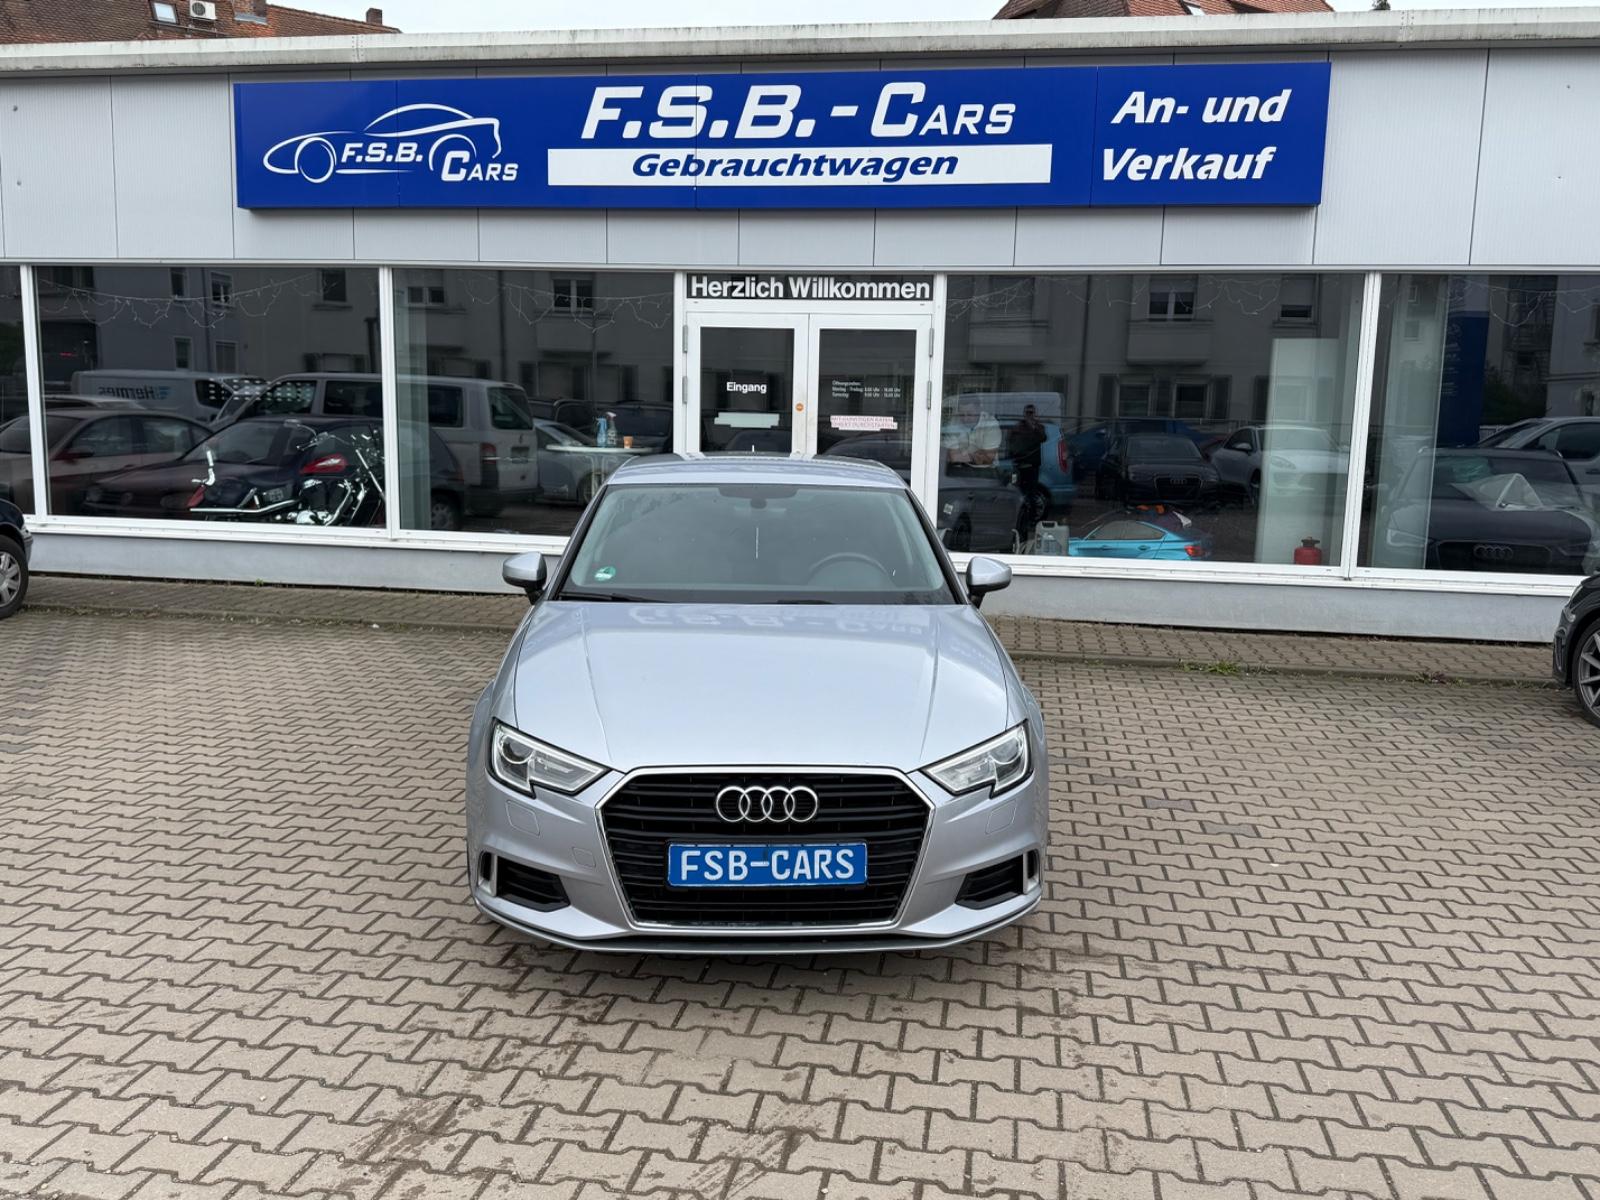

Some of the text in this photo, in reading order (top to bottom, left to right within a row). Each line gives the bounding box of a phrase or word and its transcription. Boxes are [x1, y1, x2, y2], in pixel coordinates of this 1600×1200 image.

[582, 84, 816, 139] F.S.B.
[1111, 89, 1292, 124] An- und
[341, 142, 424, 164] F.S.B.
[632, 153, 959, 183] Gebrauchtwagen
[1103, 146, 1277, 181] Verkauf
[691, 276, 930, 299] Herzlich Willkommen
[726, 381, 767, 394] Eingang
[681, 849, 854, 881] FSB-CARS
